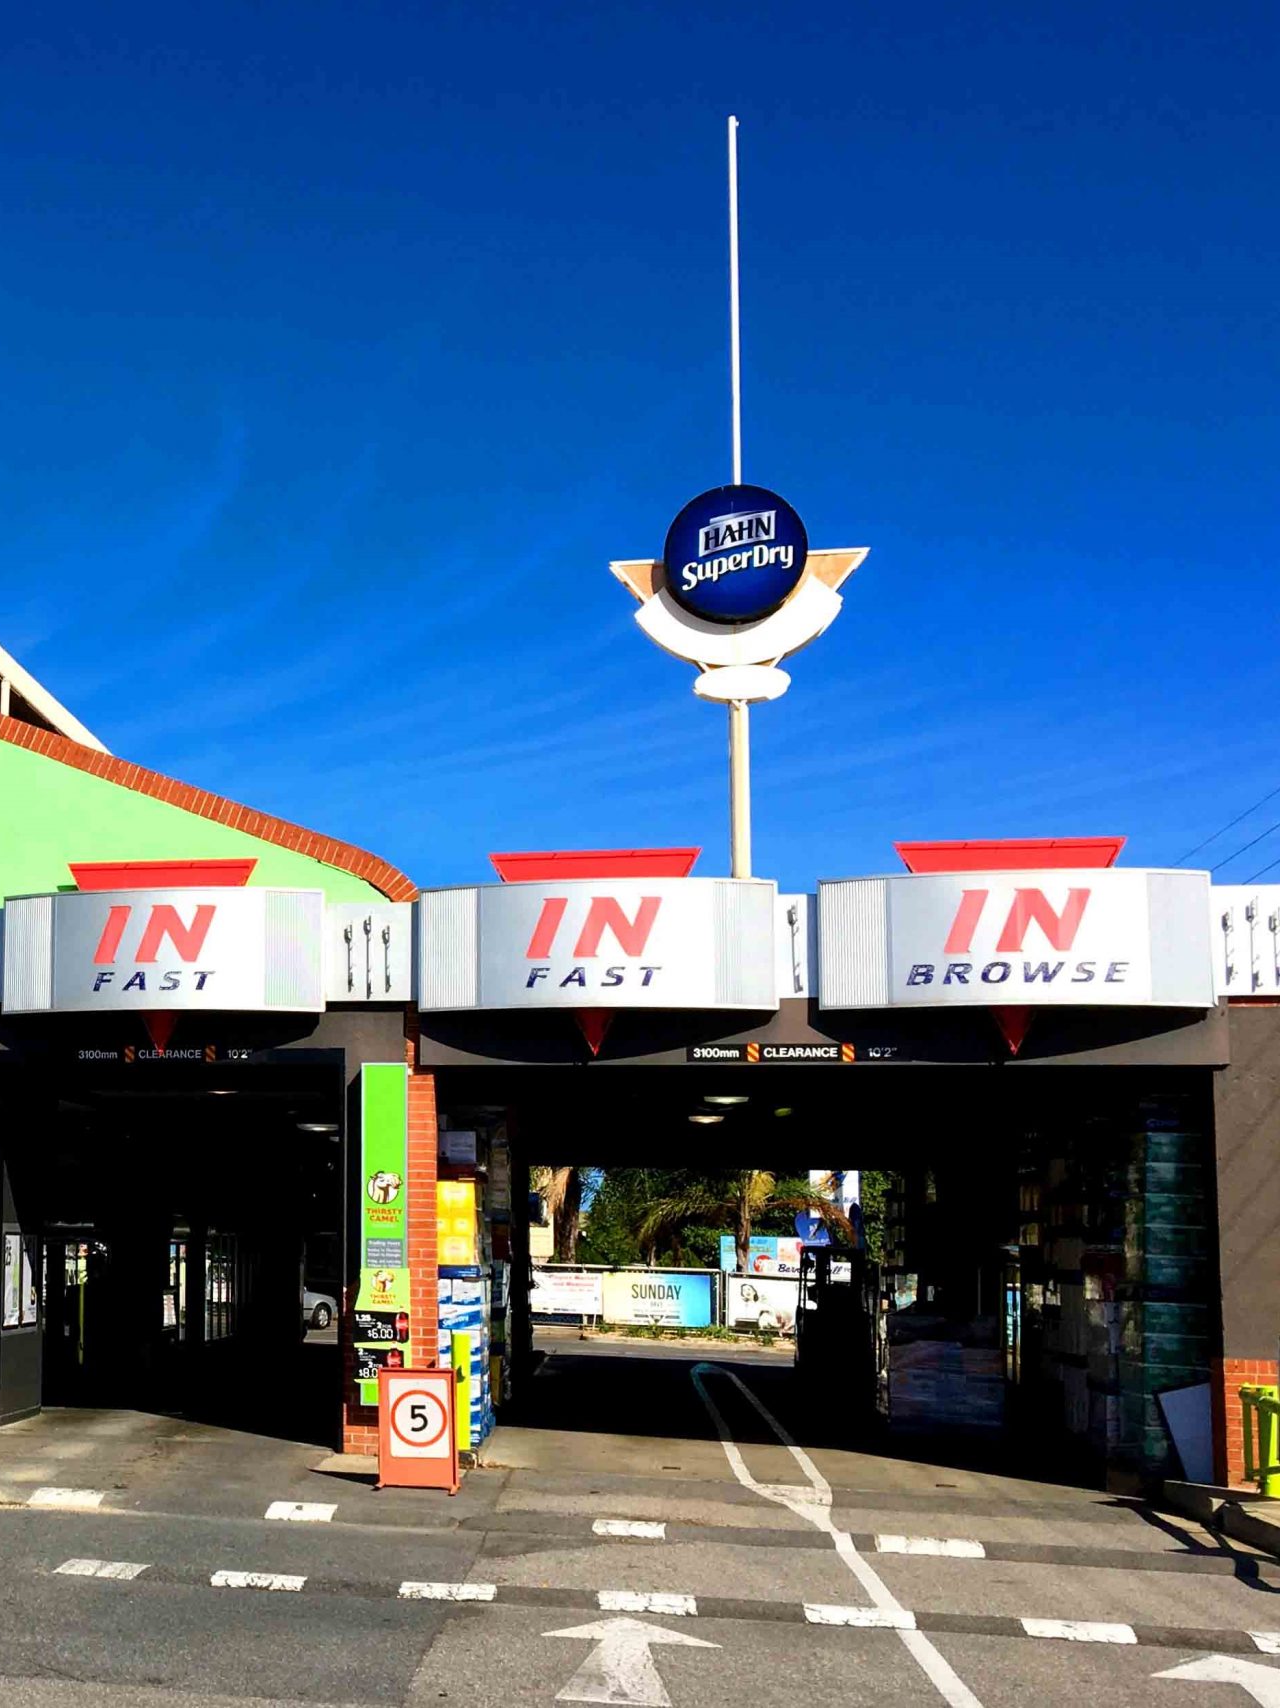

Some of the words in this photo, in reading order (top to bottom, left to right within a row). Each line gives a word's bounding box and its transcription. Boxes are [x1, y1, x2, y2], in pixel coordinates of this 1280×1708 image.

[703, 516, 772, 551] HAHN
[682, 545, 794, 591] SuperDry
[525, 896, 663, 959] IN
[943, 888, 1092, 953] IN
[92, 904, 217, 965] IN
[93, 971, 217, 992] FAST
[526, 966, 663, 988] FAST
[906, 961, 1130, 986] BROWSE
[78, 1049, 118, 1060] 3100mm
[138, 1049, 202, 1060] CLEARANCE
[693, 1047, 740, 1058] 3100mm
[763, 1047, 839, 1058] CLEARANCE
[369, 1215, 399, 1223] CAMEL
[631, 1284, 682, 1300] SUNDAY
[367, 1328, 394, 1339] $6.00
[359, 1367, 379, 1378] $8.0
[410, 1404, 429, 1432] 5
